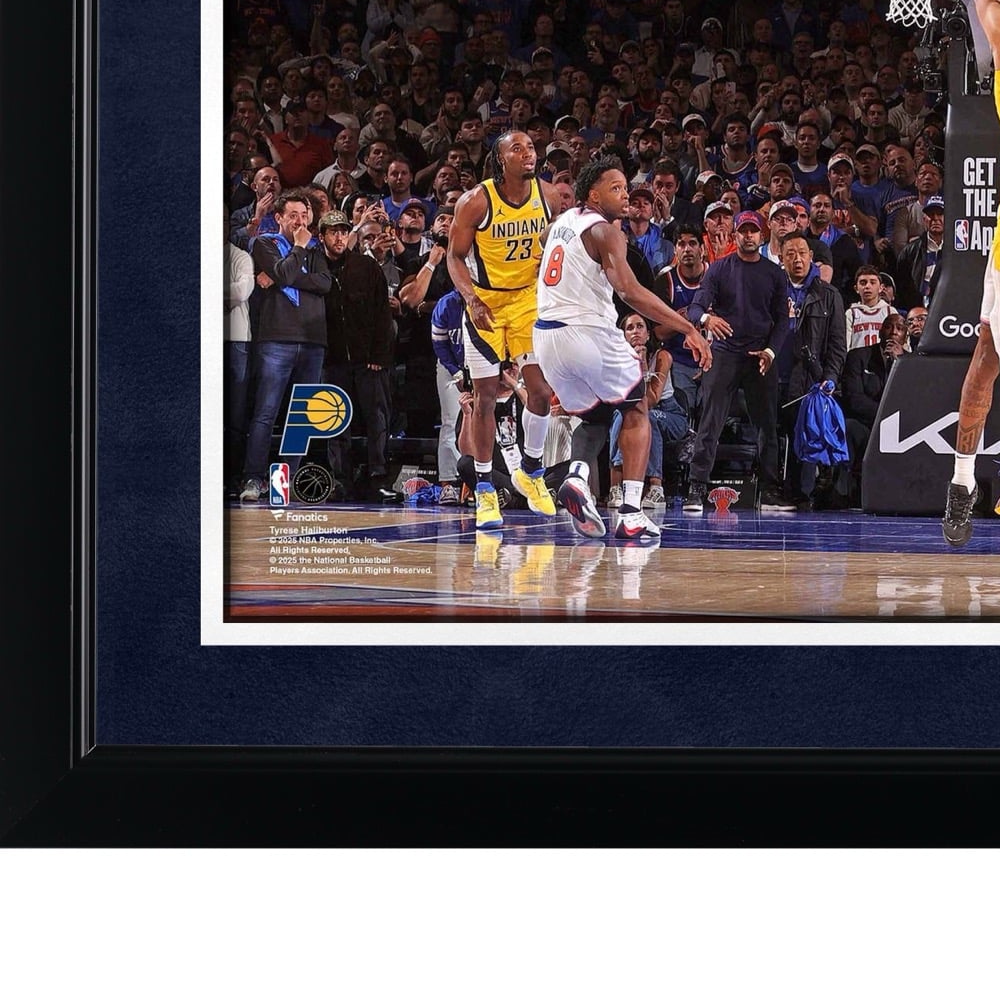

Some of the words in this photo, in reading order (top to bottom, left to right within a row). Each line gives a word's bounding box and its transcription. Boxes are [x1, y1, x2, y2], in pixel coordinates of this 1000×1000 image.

[963, 157, 997, 186] GET
[963, 188, 997, 217] THE
[492, 216, 546, 239] INDIANA
[505, 238, 533, 261] 23
[543, 244, 565, 287] 8
